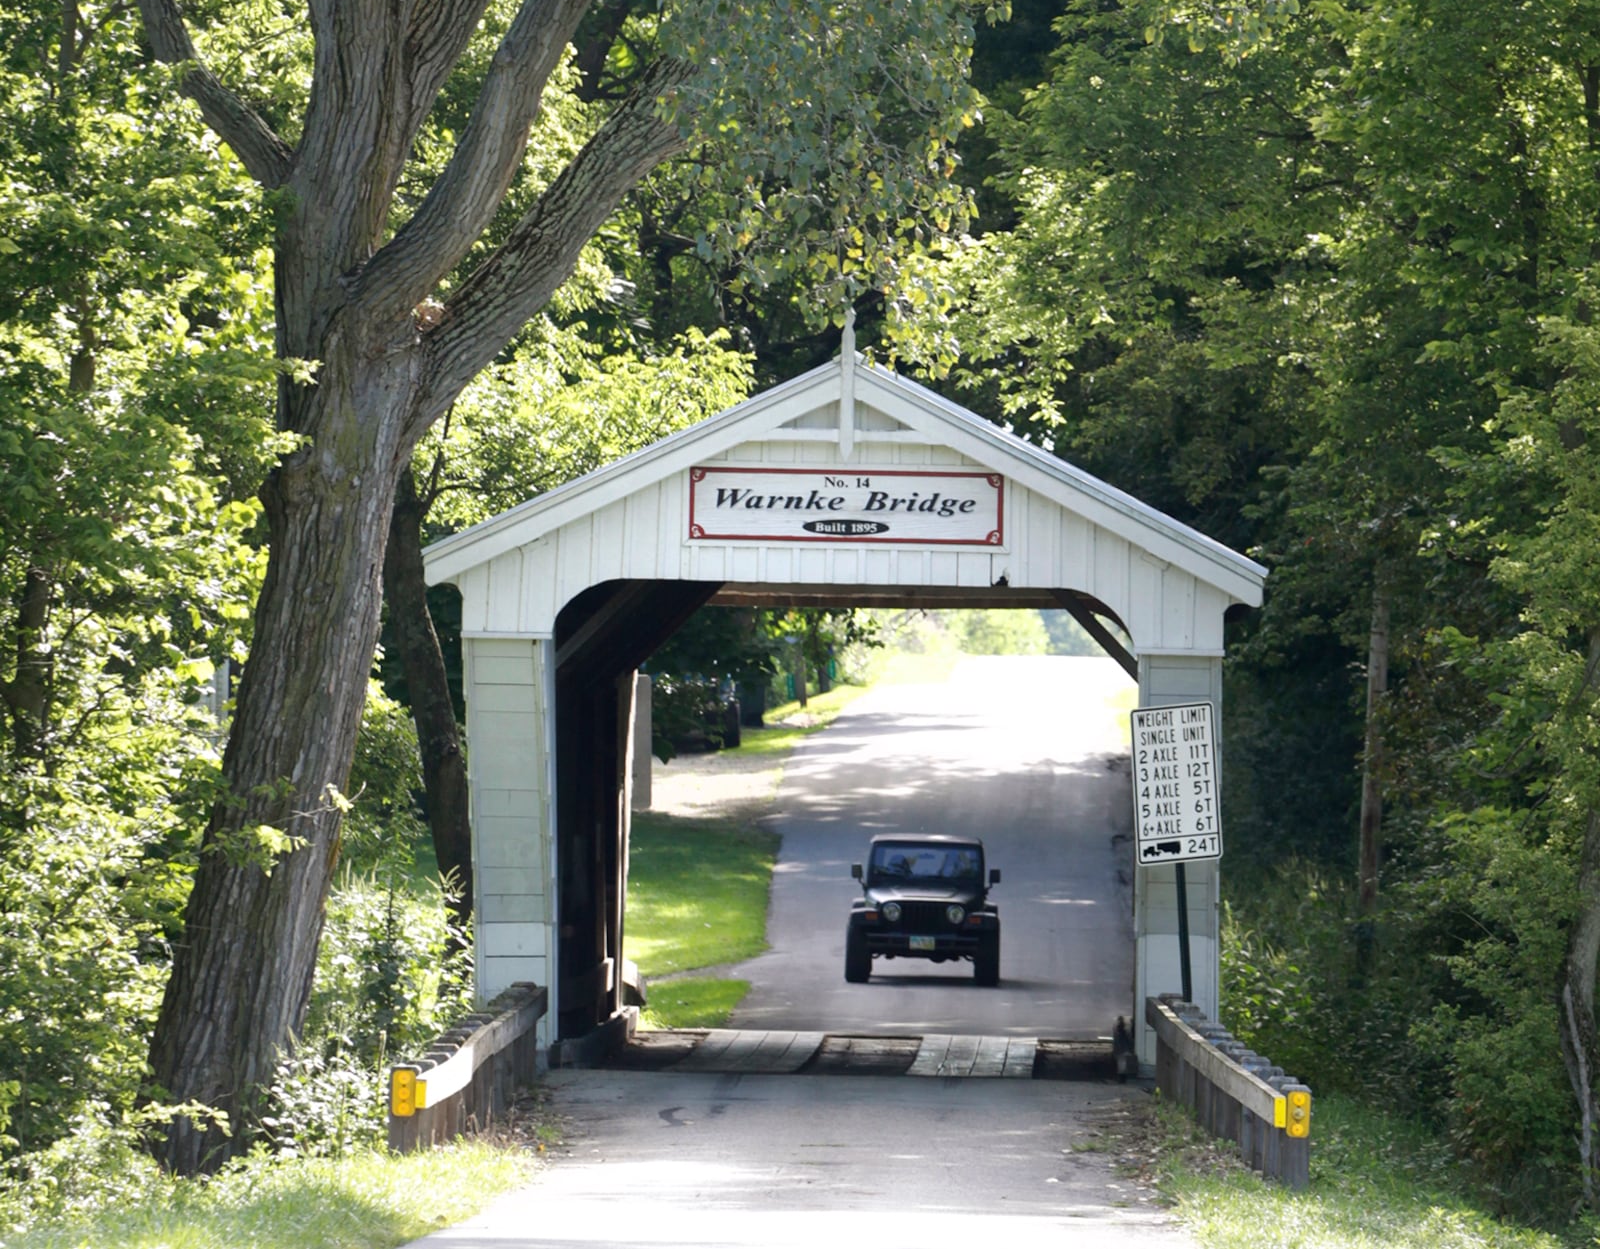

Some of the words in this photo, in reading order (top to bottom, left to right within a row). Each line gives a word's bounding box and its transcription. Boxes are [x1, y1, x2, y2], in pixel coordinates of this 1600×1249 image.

[824, 476, 848, 488] No.
[856, 478, 870, 488] 14
[716, 488, 845, 511] Warnke
[864, 491, 976, 516] Bridge
[815, 523, 846, 532] Built
[851, 523, 878, 533] 1895
[1137, 711, 1173, 727] WEIGHT
[1181, 708, 1206, 724] LIMIT
[1141, 729, 1175, 746] SINGLE
[1183, 726, 1205, 742] UNIT
[1139, 751, 1148, 764] 2
[1153, 747, 1178, 763] AXLE
[1190, 744, 1208, 759] 11T
[1141, 768, 1149, 782] 3
[1154, 765, 1179, 781] AXLE
[1187, 762, 1209, 777] 12T
[1142, 787, 1150, 799] 4
[1155, 783, 1180, 799] AXLE
[1194, 780, 1210, 795] 5T
[1143, 805, 1151, 818] 5
[1156, 801, 1181, 817] AXLE
[1195, 798, 1211, 813] 6T
[1157, 819, 1182, 835] AXLE
[1196, 816, 1213, 831] 6T
[1188, 837, 1216, 853] 24T
